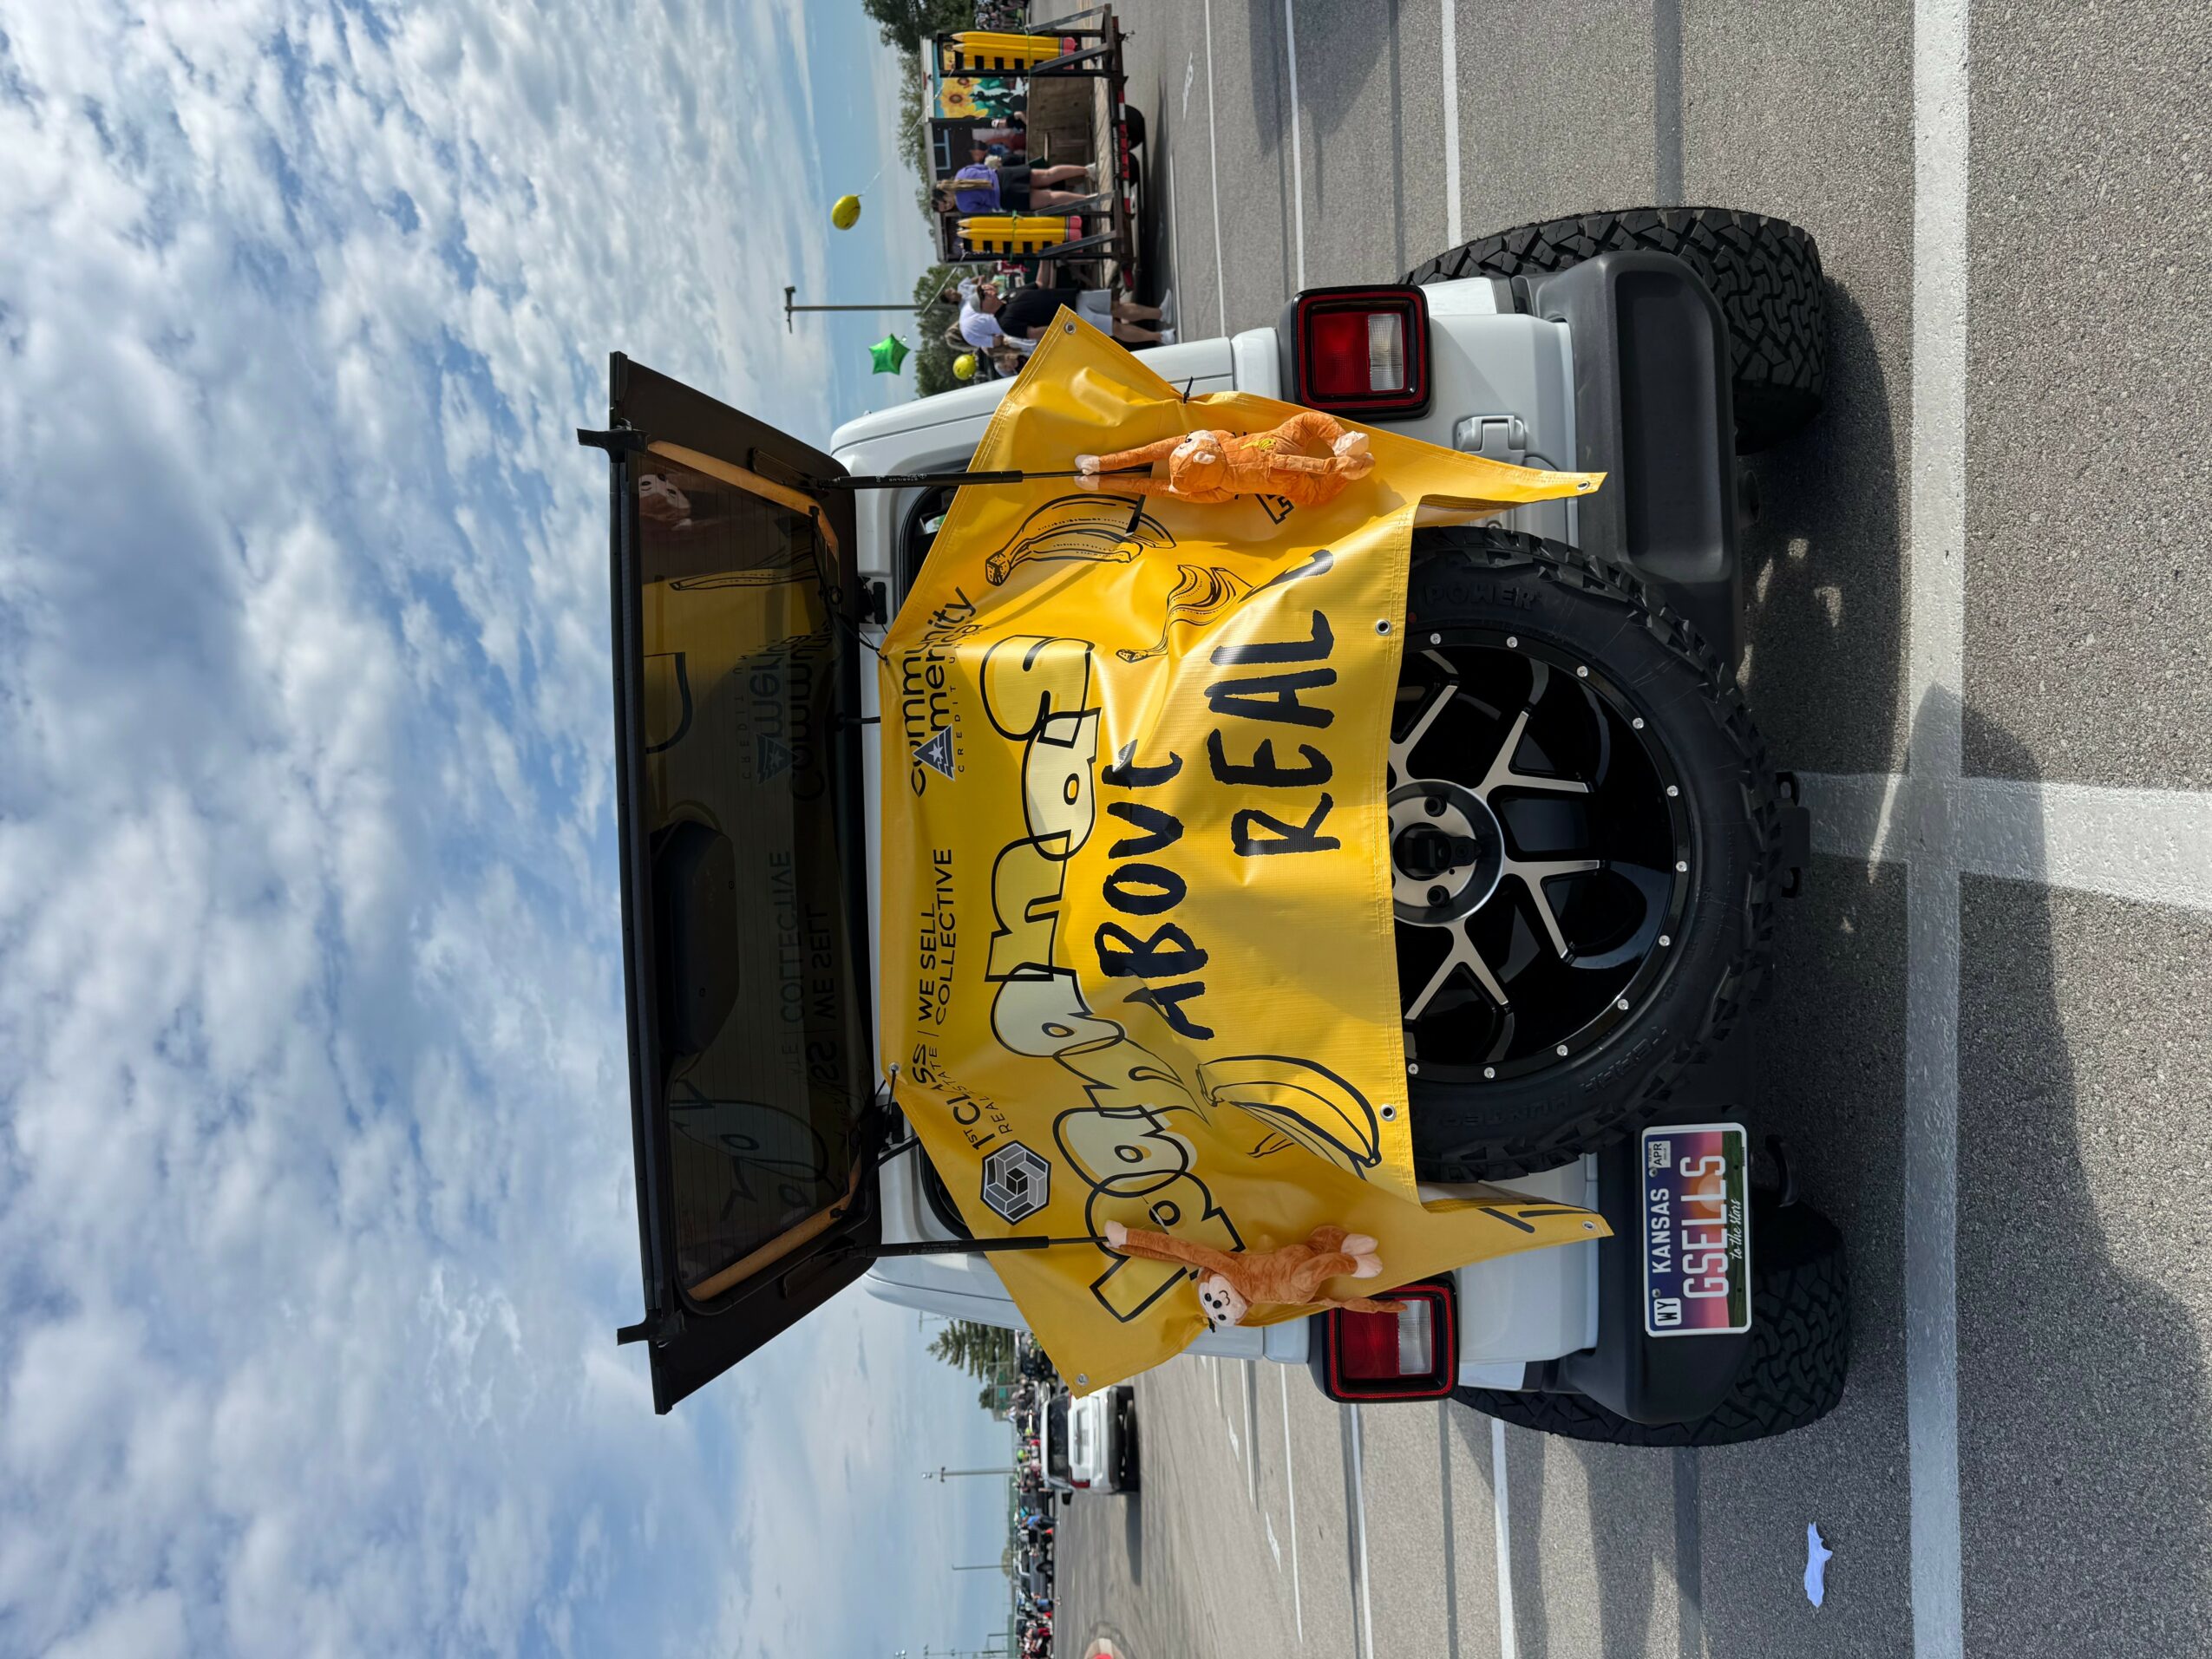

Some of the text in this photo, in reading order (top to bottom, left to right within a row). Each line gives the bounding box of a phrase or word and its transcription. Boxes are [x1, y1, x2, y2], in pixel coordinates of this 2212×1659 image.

[1419, 581, 1538, 611] POWER
[948, 684, 965, 773] CREDIT
[1203, 608, 1343, 857] REAL
[1093, 739, 1216, 1042] ABOVE
[918, 902, 937, 1022] WE SELL
[933, 848, 957, 1026] COLLECTIVE
[978, 1094, 1013, 1135] REAL
[1653, 1142, 1663, 1166] APR
[1650, 1188, 1672, 1274] KANSAS
[1679, 1155, 1730, 1299] GSELLS
[1726, 1198, 1743, 1260] to the stars
[1656, 1301, 1678, 1322] WY
